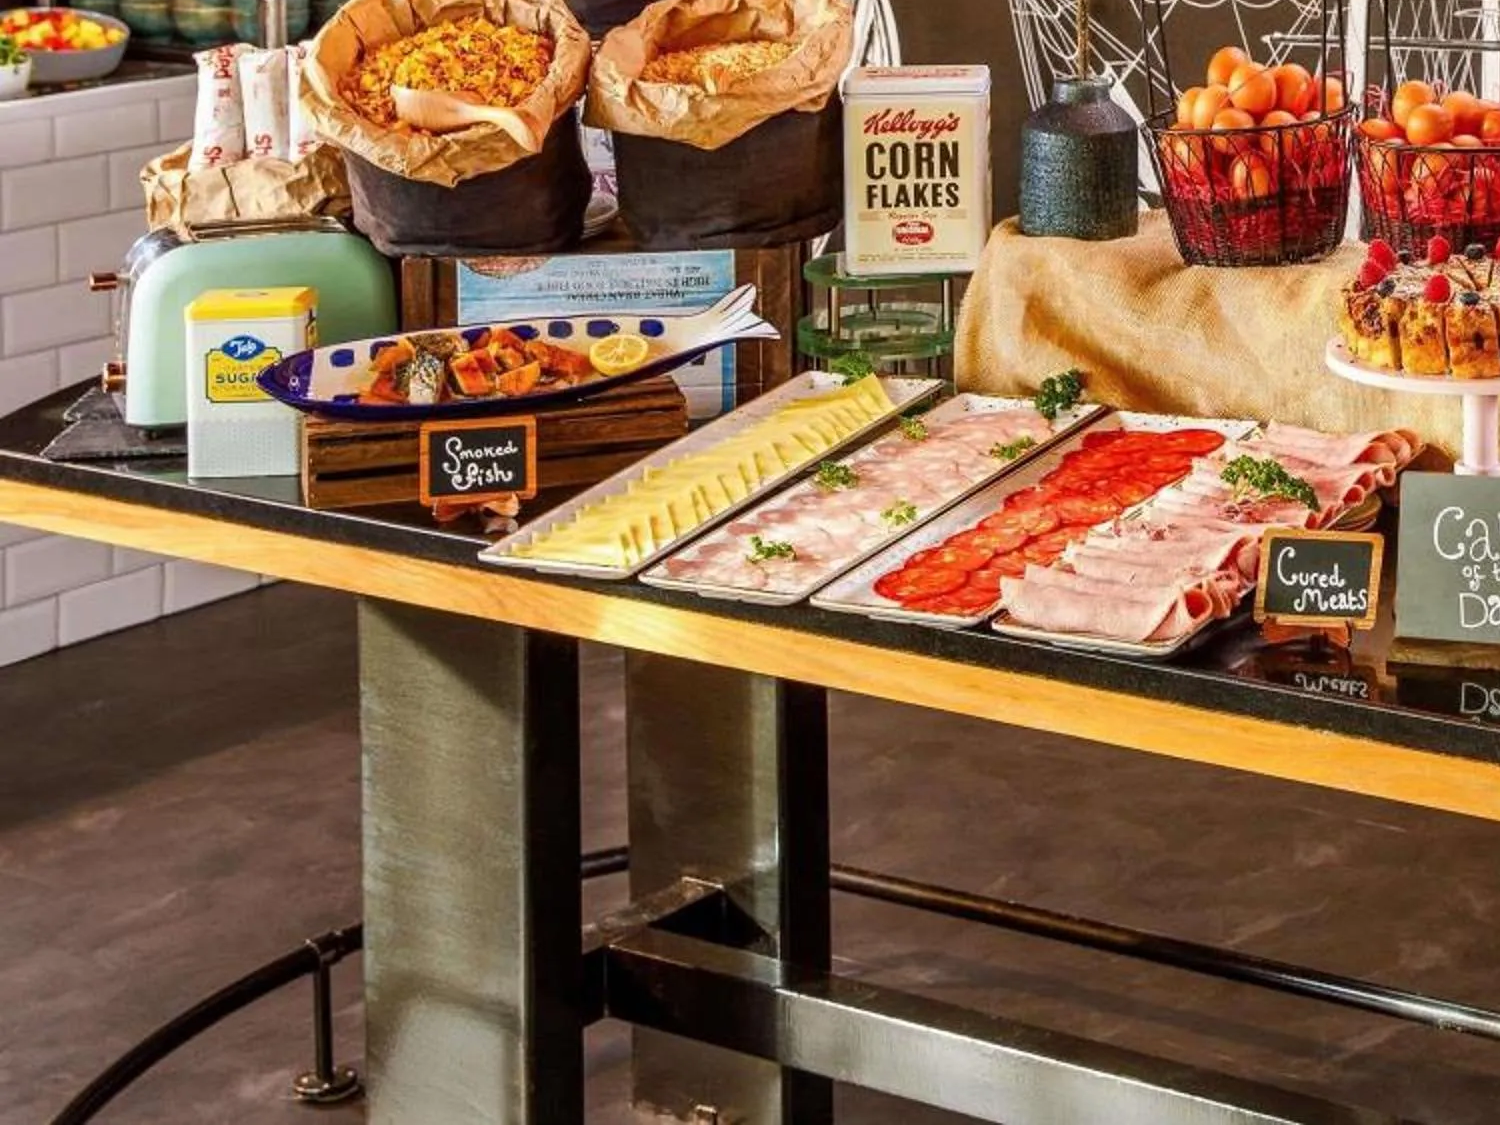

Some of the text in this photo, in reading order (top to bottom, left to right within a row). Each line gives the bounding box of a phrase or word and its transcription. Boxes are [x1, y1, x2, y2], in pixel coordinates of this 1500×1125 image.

[864, 107, 961, 139] Kellogg's
[866, 142, 960, 180] CORN
[866, 182, 960, 209] FLAKES
[215, 372, 257, 384] SUG
[442, 436, 519, 474] Smoked
[1277, 546, 1346, 587] Cured
[1462, 564, 1486, 591] of
[1294, 587, 1368, 611] Meats
